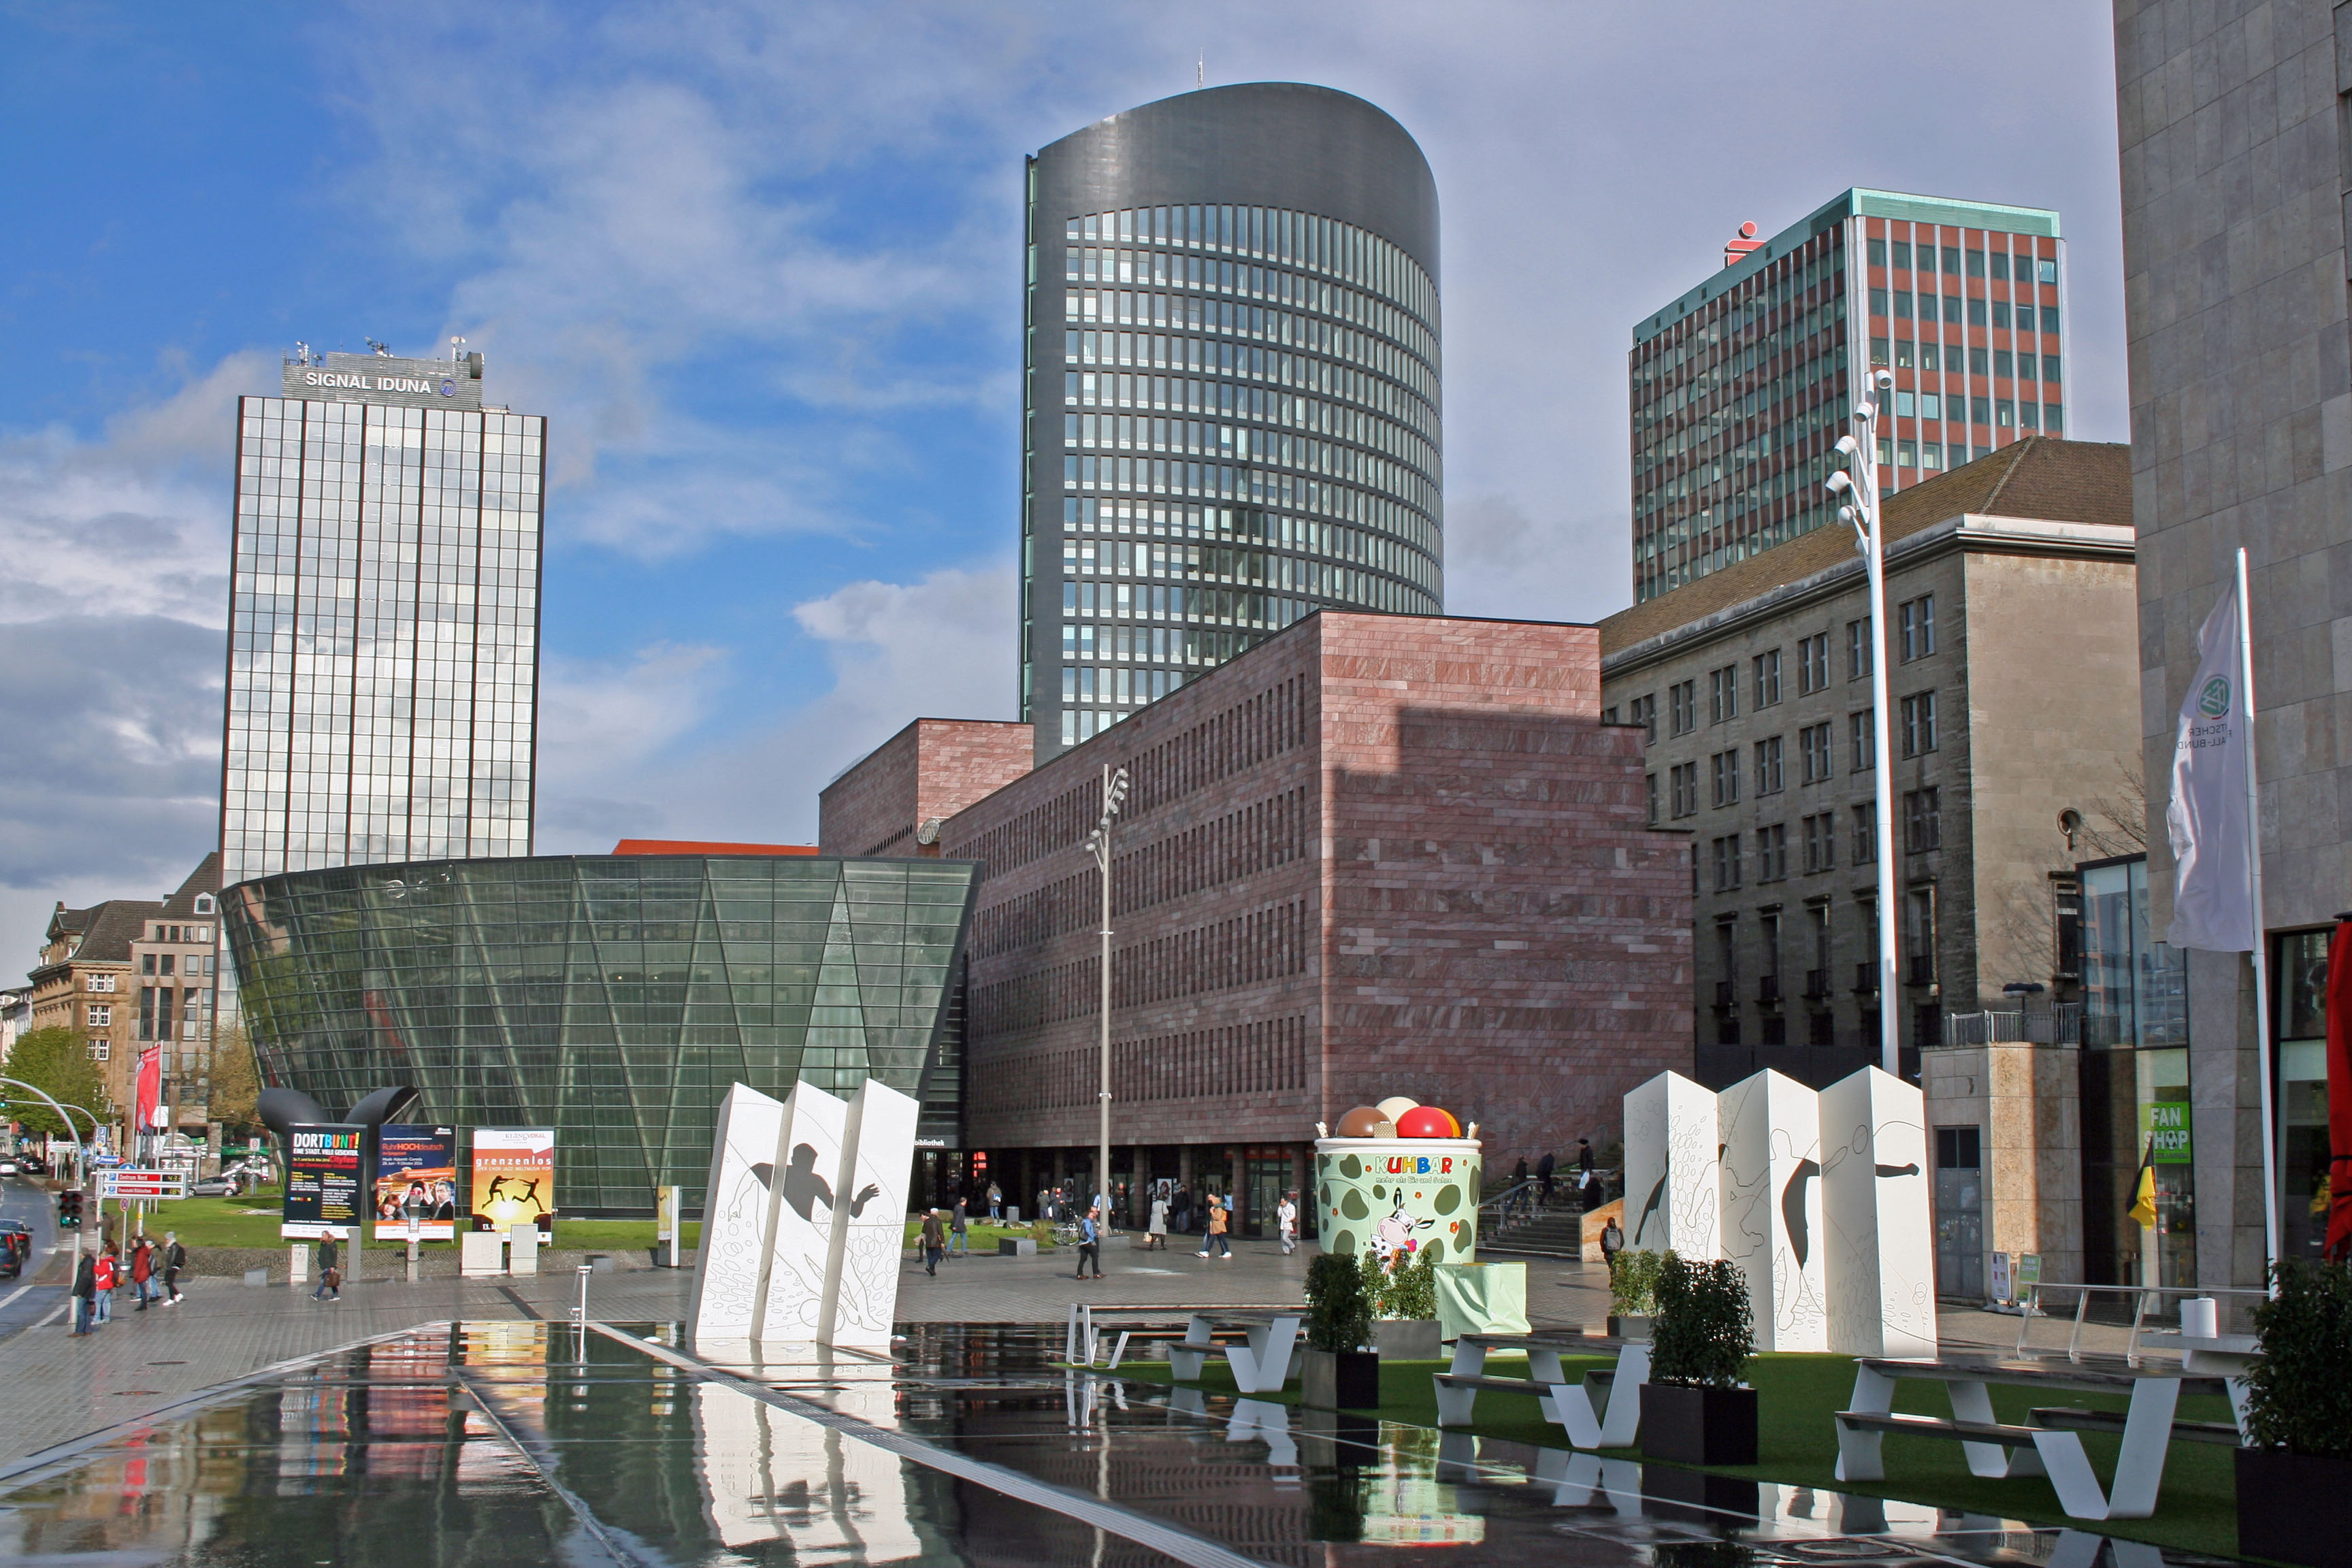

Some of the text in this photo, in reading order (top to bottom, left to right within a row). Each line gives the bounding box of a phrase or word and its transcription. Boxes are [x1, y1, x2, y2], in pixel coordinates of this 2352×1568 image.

[306, 372, 432, 394] SIGNAL IDUNA
[2150, 1107, 2180, 1128] FAN
[293, 1132, 360, 1149] DORTBUNT!
[476, 1155, 551, 1167] grenzenlos
[1375, 1156, 1453, 1174] KUHBAR
